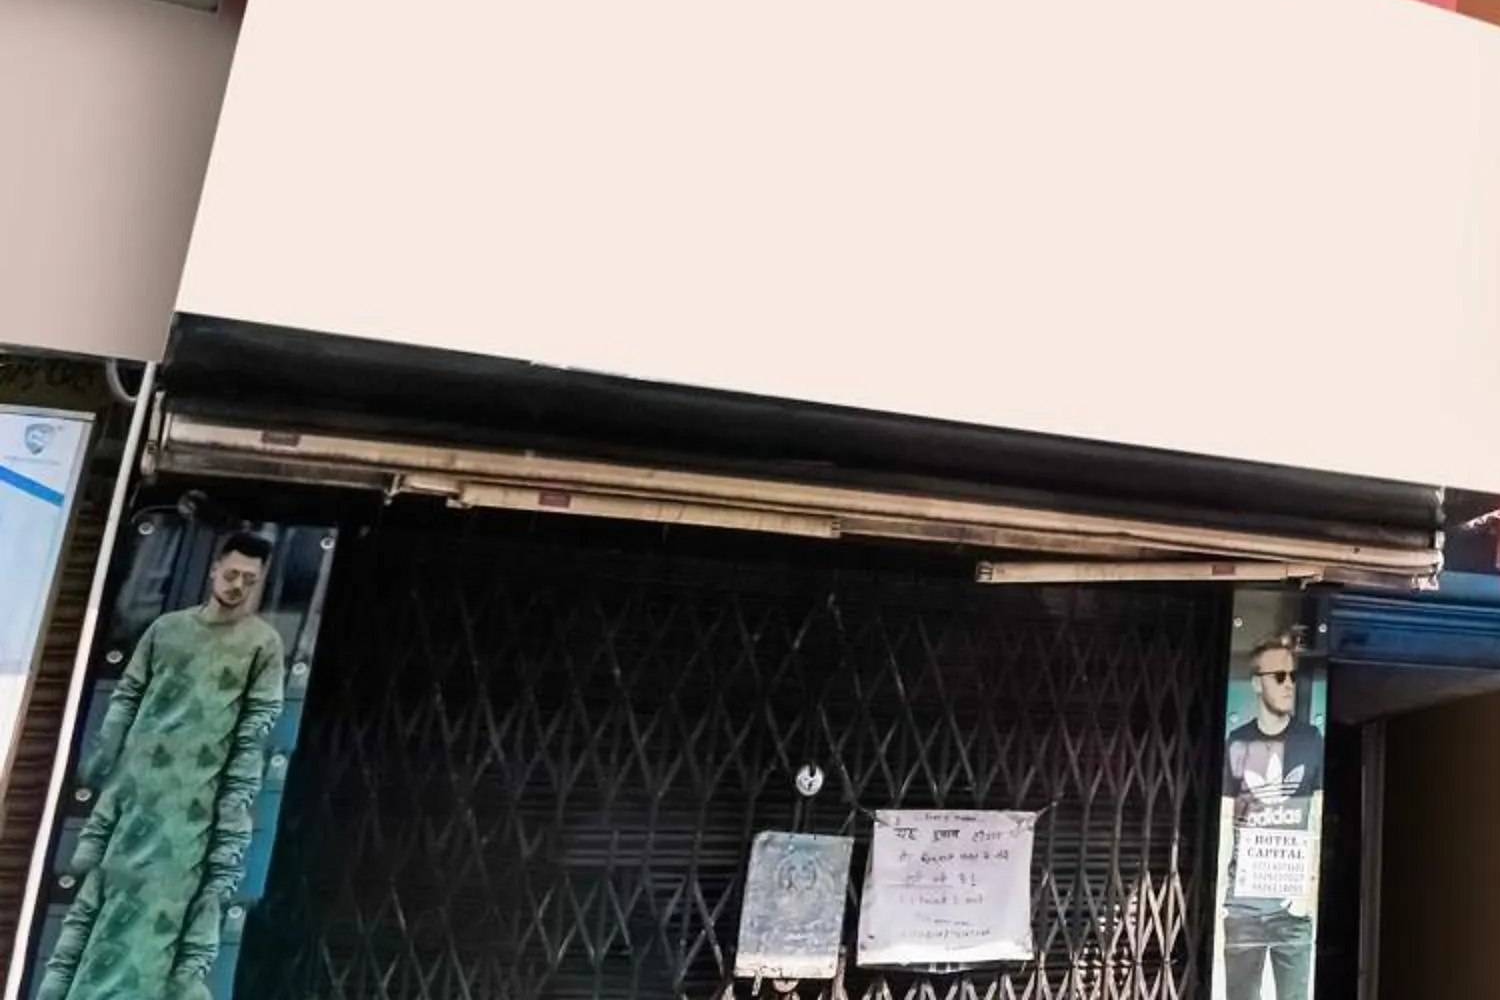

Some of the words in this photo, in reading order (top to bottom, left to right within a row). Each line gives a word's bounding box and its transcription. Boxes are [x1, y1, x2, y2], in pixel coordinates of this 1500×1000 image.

[1247, 806, 1302, 827] adidas
[1255, 834, 1298, 846] HOTEL
[1247, 846, 1305, 860] CAPITAL
